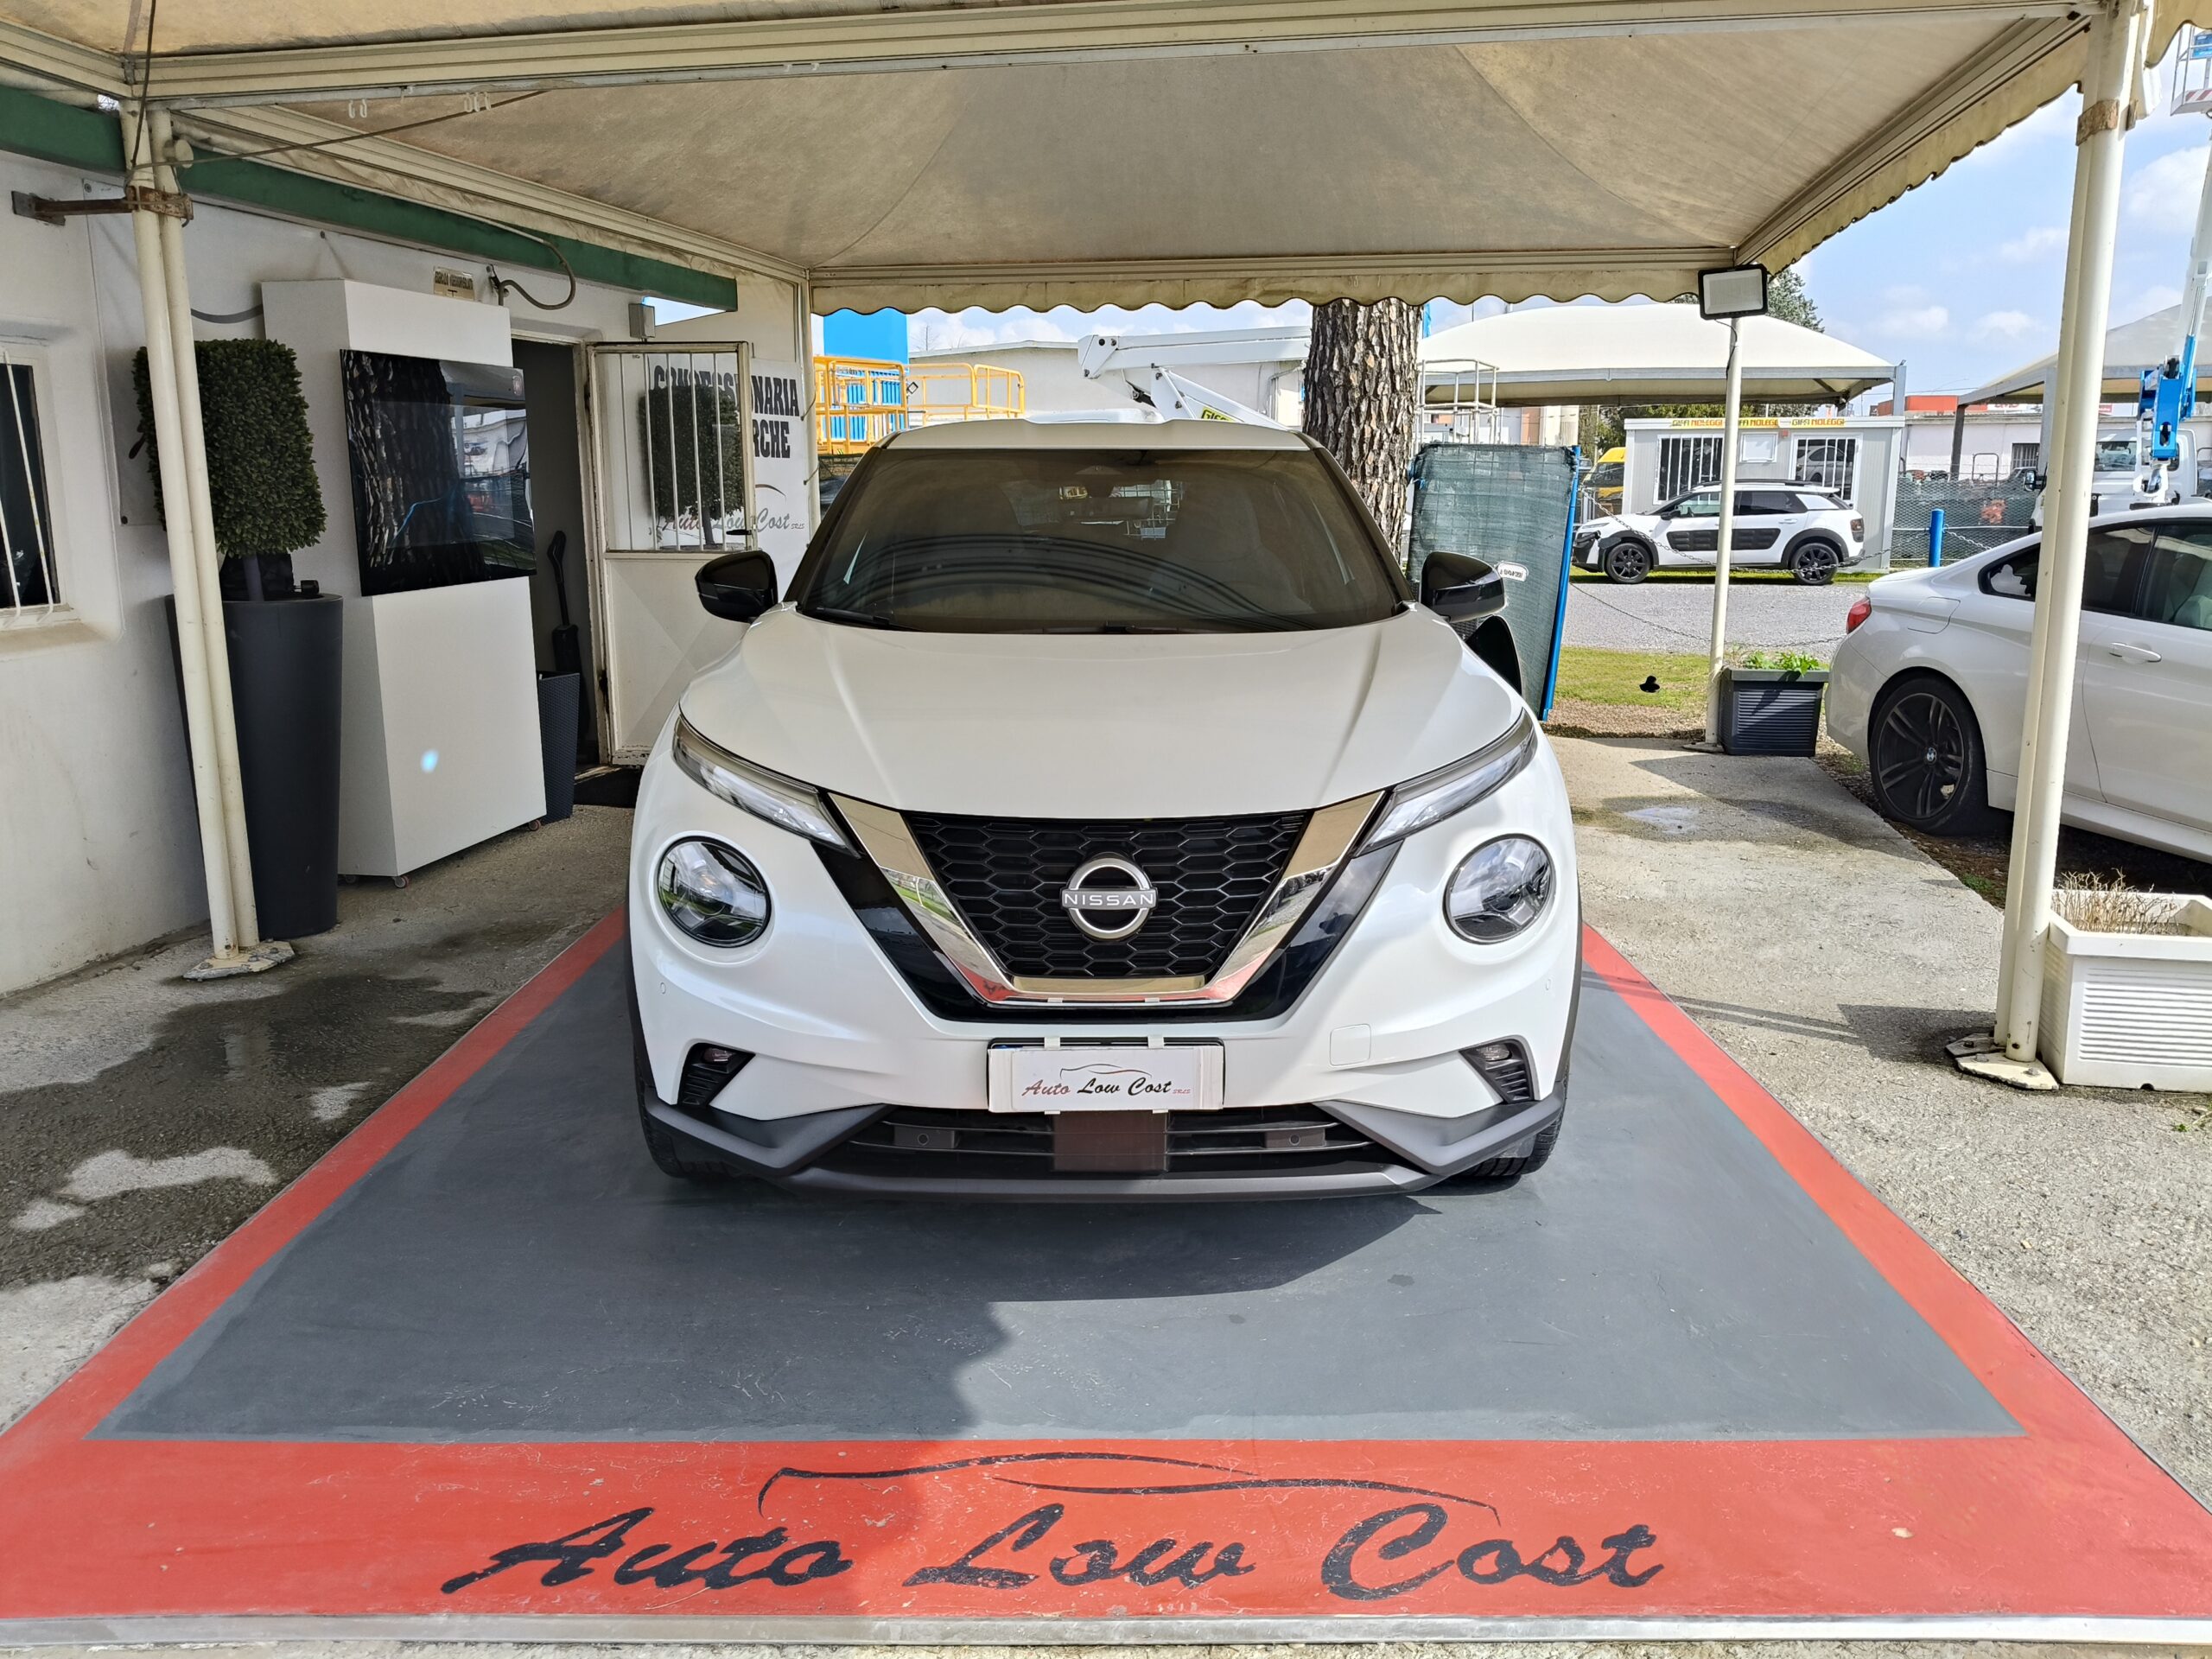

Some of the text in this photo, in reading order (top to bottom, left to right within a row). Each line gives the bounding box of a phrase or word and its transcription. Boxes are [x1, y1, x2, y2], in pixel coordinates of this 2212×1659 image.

[756, 508, 790, 532] Cost
[1064, 893, 1154, 906] NISSAN
[1021, 1079, 1071, 1096] Auto
[1077, 1077, 1121, 1094] Low
[1128, 1077, 1172, 1096] Cost
[441, 1503, 1666, 1601] Auto Low Cost
